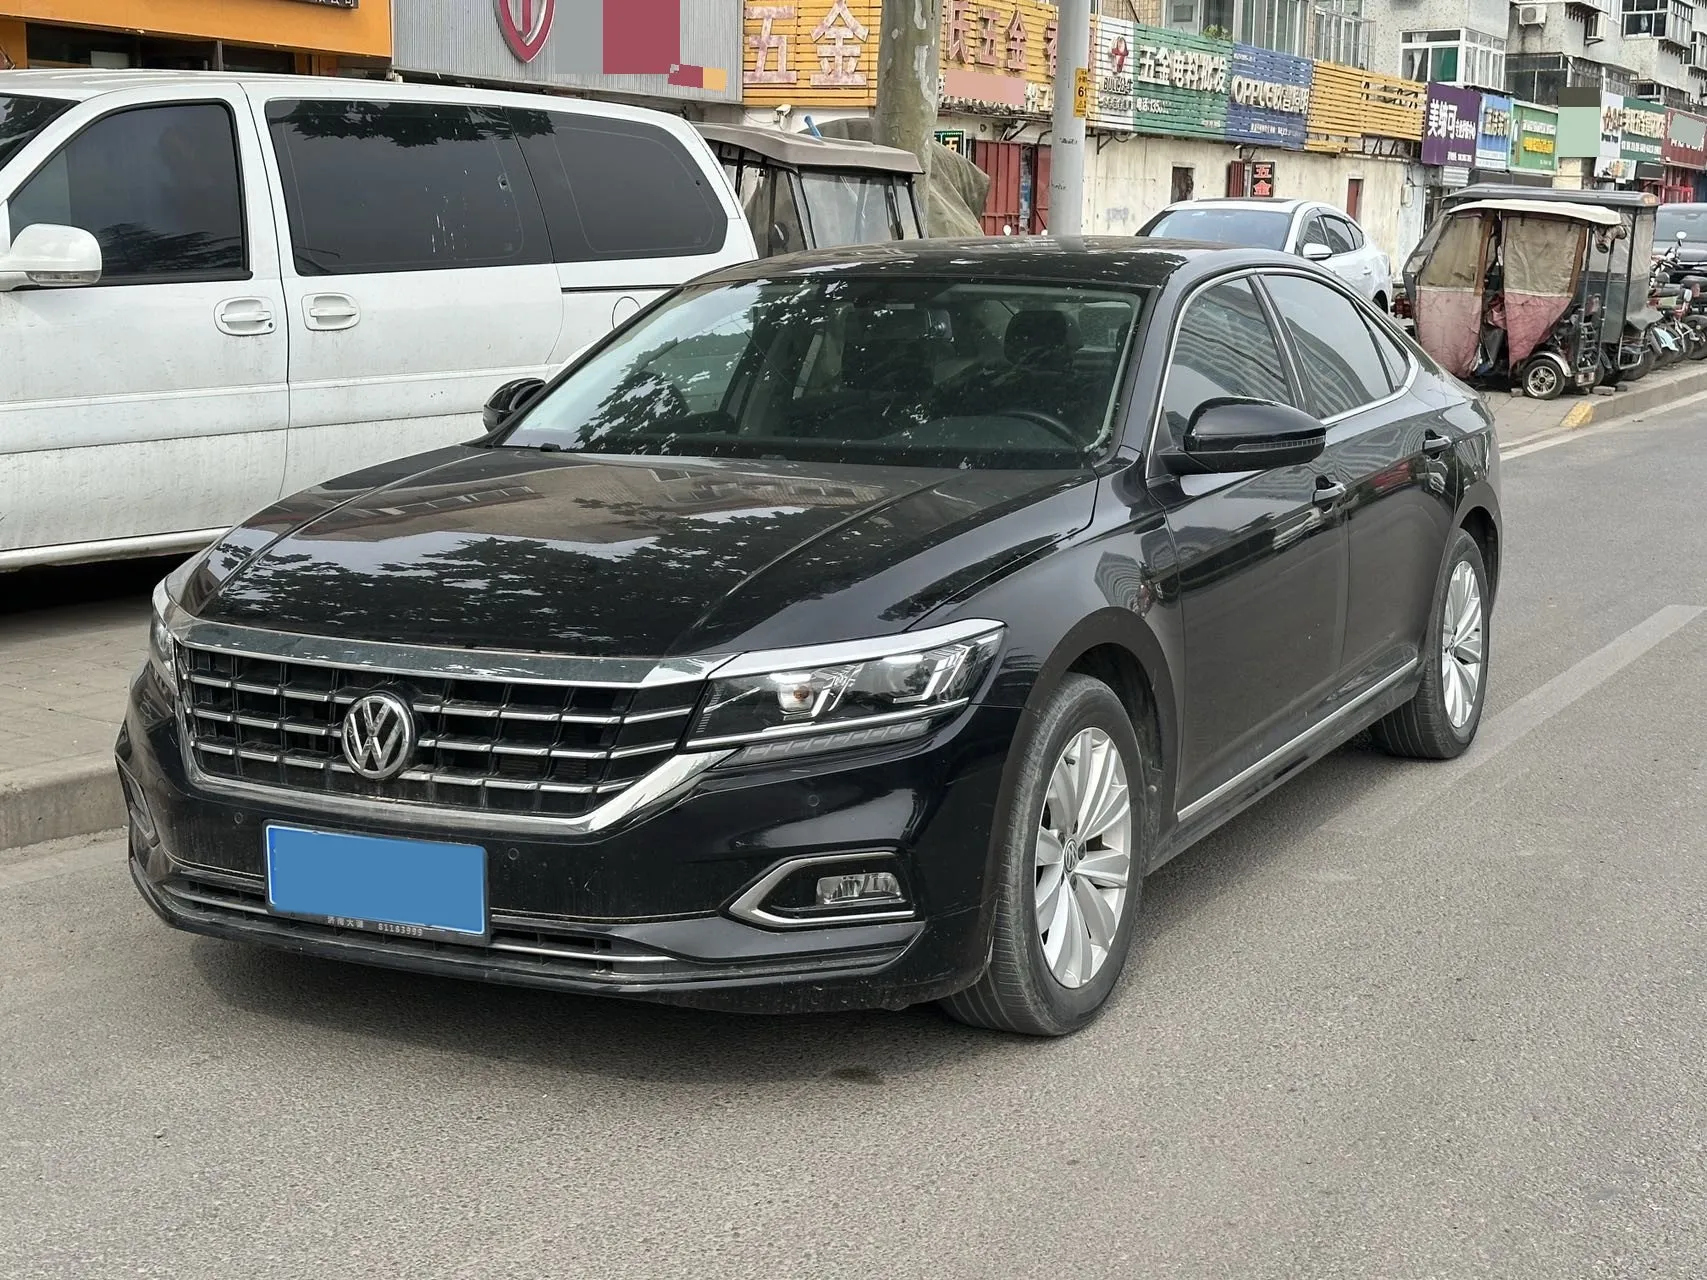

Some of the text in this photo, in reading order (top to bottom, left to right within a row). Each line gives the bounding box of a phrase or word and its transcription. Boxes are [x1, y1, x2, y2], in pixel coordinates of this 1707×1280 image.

[743, 1, 870, 86] 五金
[1138, 45, 1227, 94] 五金电料批发
[1253, 164, 1272, 196] 五金
